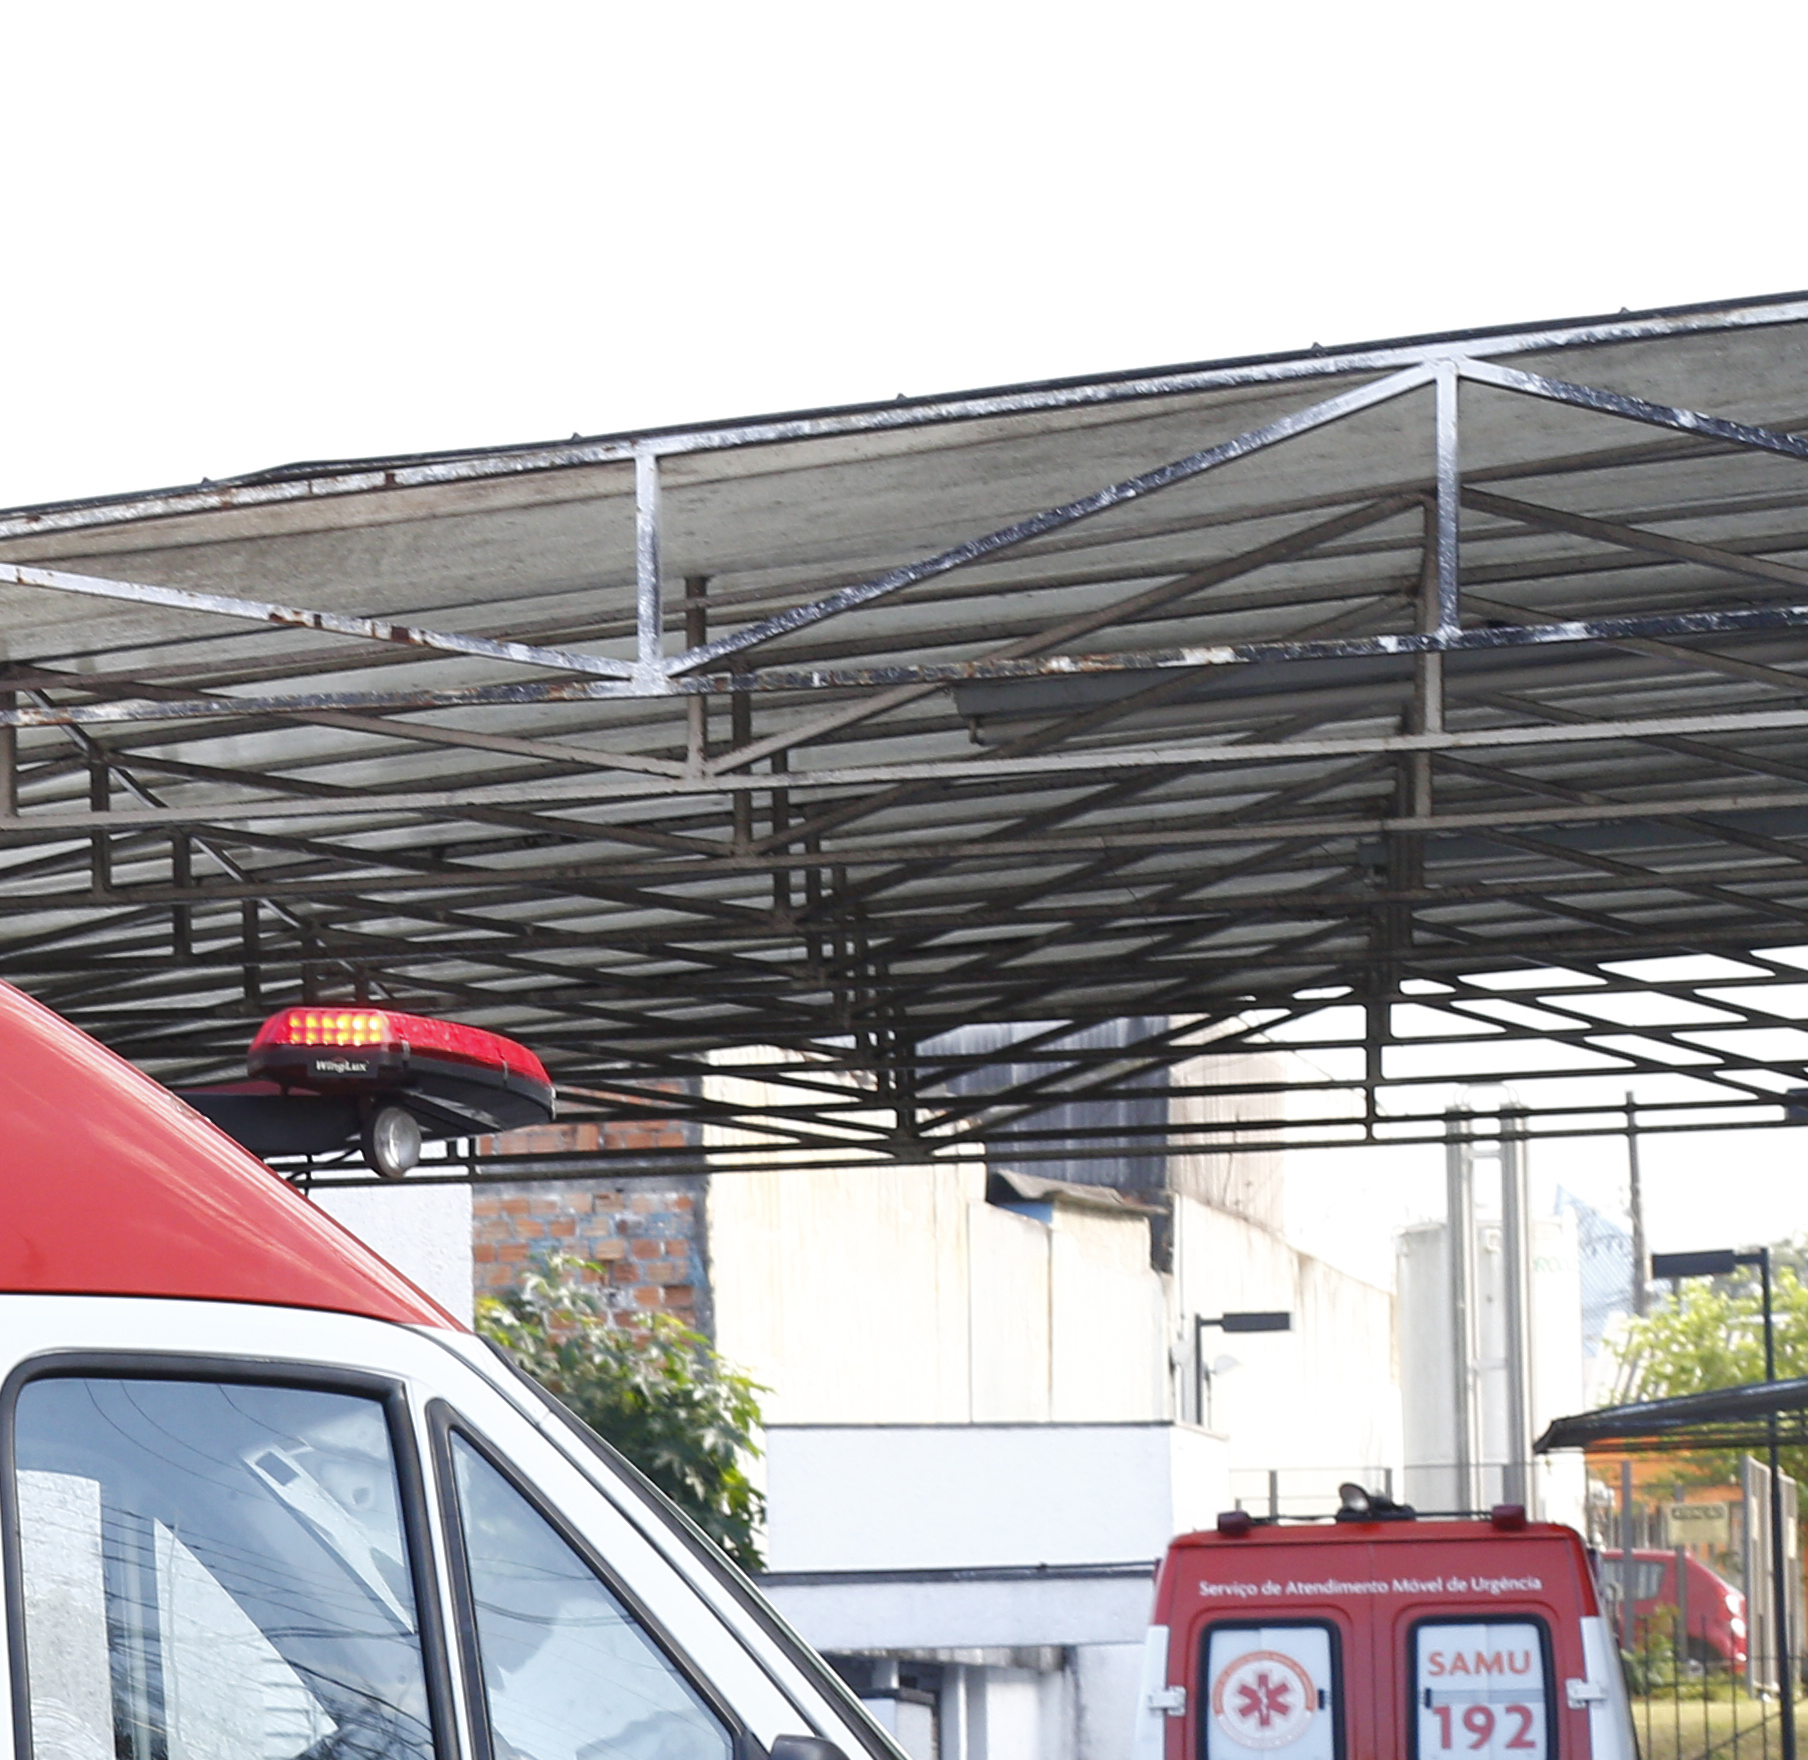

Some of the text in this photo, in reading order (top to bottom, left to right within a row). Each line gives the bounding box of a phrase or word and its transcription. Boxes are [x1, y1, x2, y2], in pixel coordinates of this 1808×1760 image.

[1199, 1575, 1543, 1598] Serviço de Atendimento Móvel de Urgência
[1428, 1650, 1532, 1677] SAMU
[1432, 1704, 1537, 1750] 192
